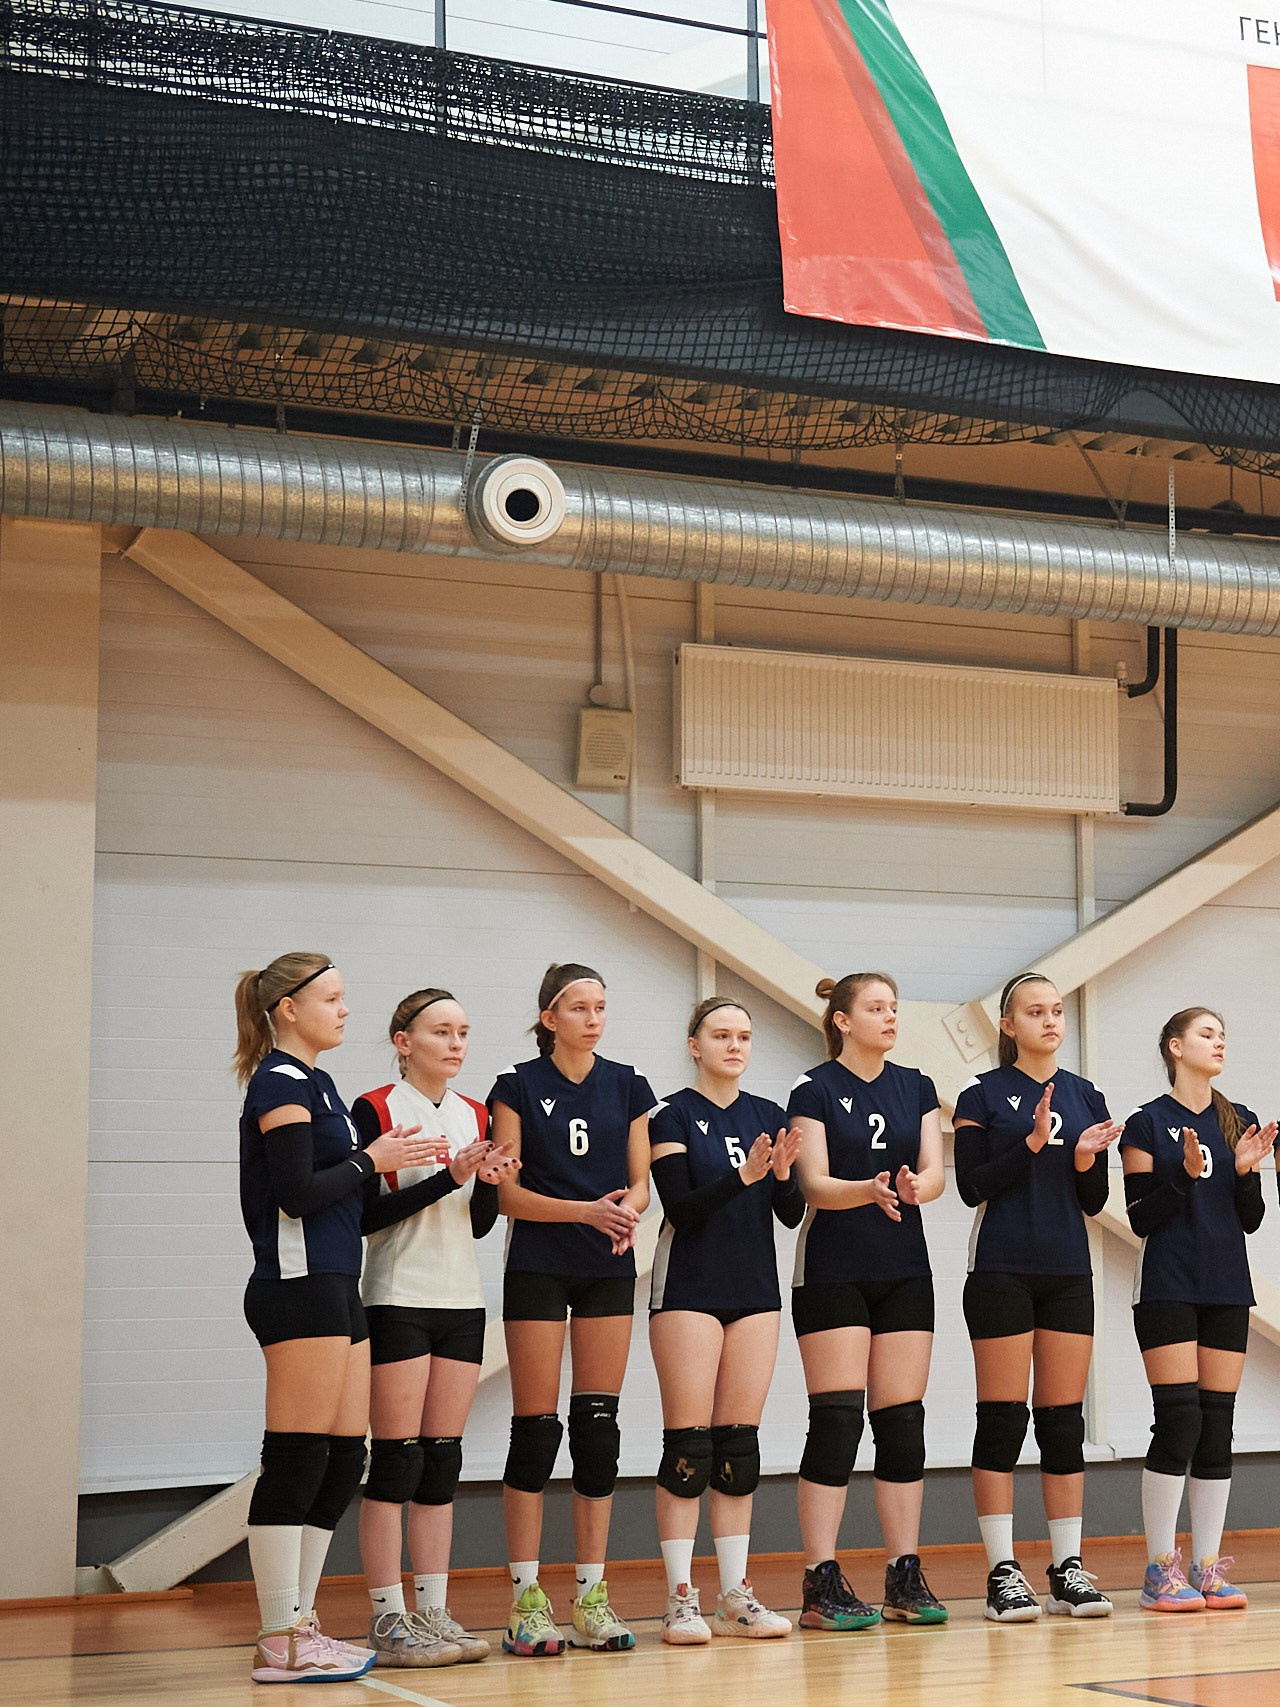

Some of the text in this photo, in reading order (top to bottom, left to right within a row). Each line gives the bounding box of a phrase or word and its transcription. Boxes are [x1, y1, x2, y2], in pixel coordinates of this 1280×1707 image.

[568, 1118, 589, 1156] 6
[868, 1113, 887, 1150] 2
[724, 1136, 747, 1169] 5
